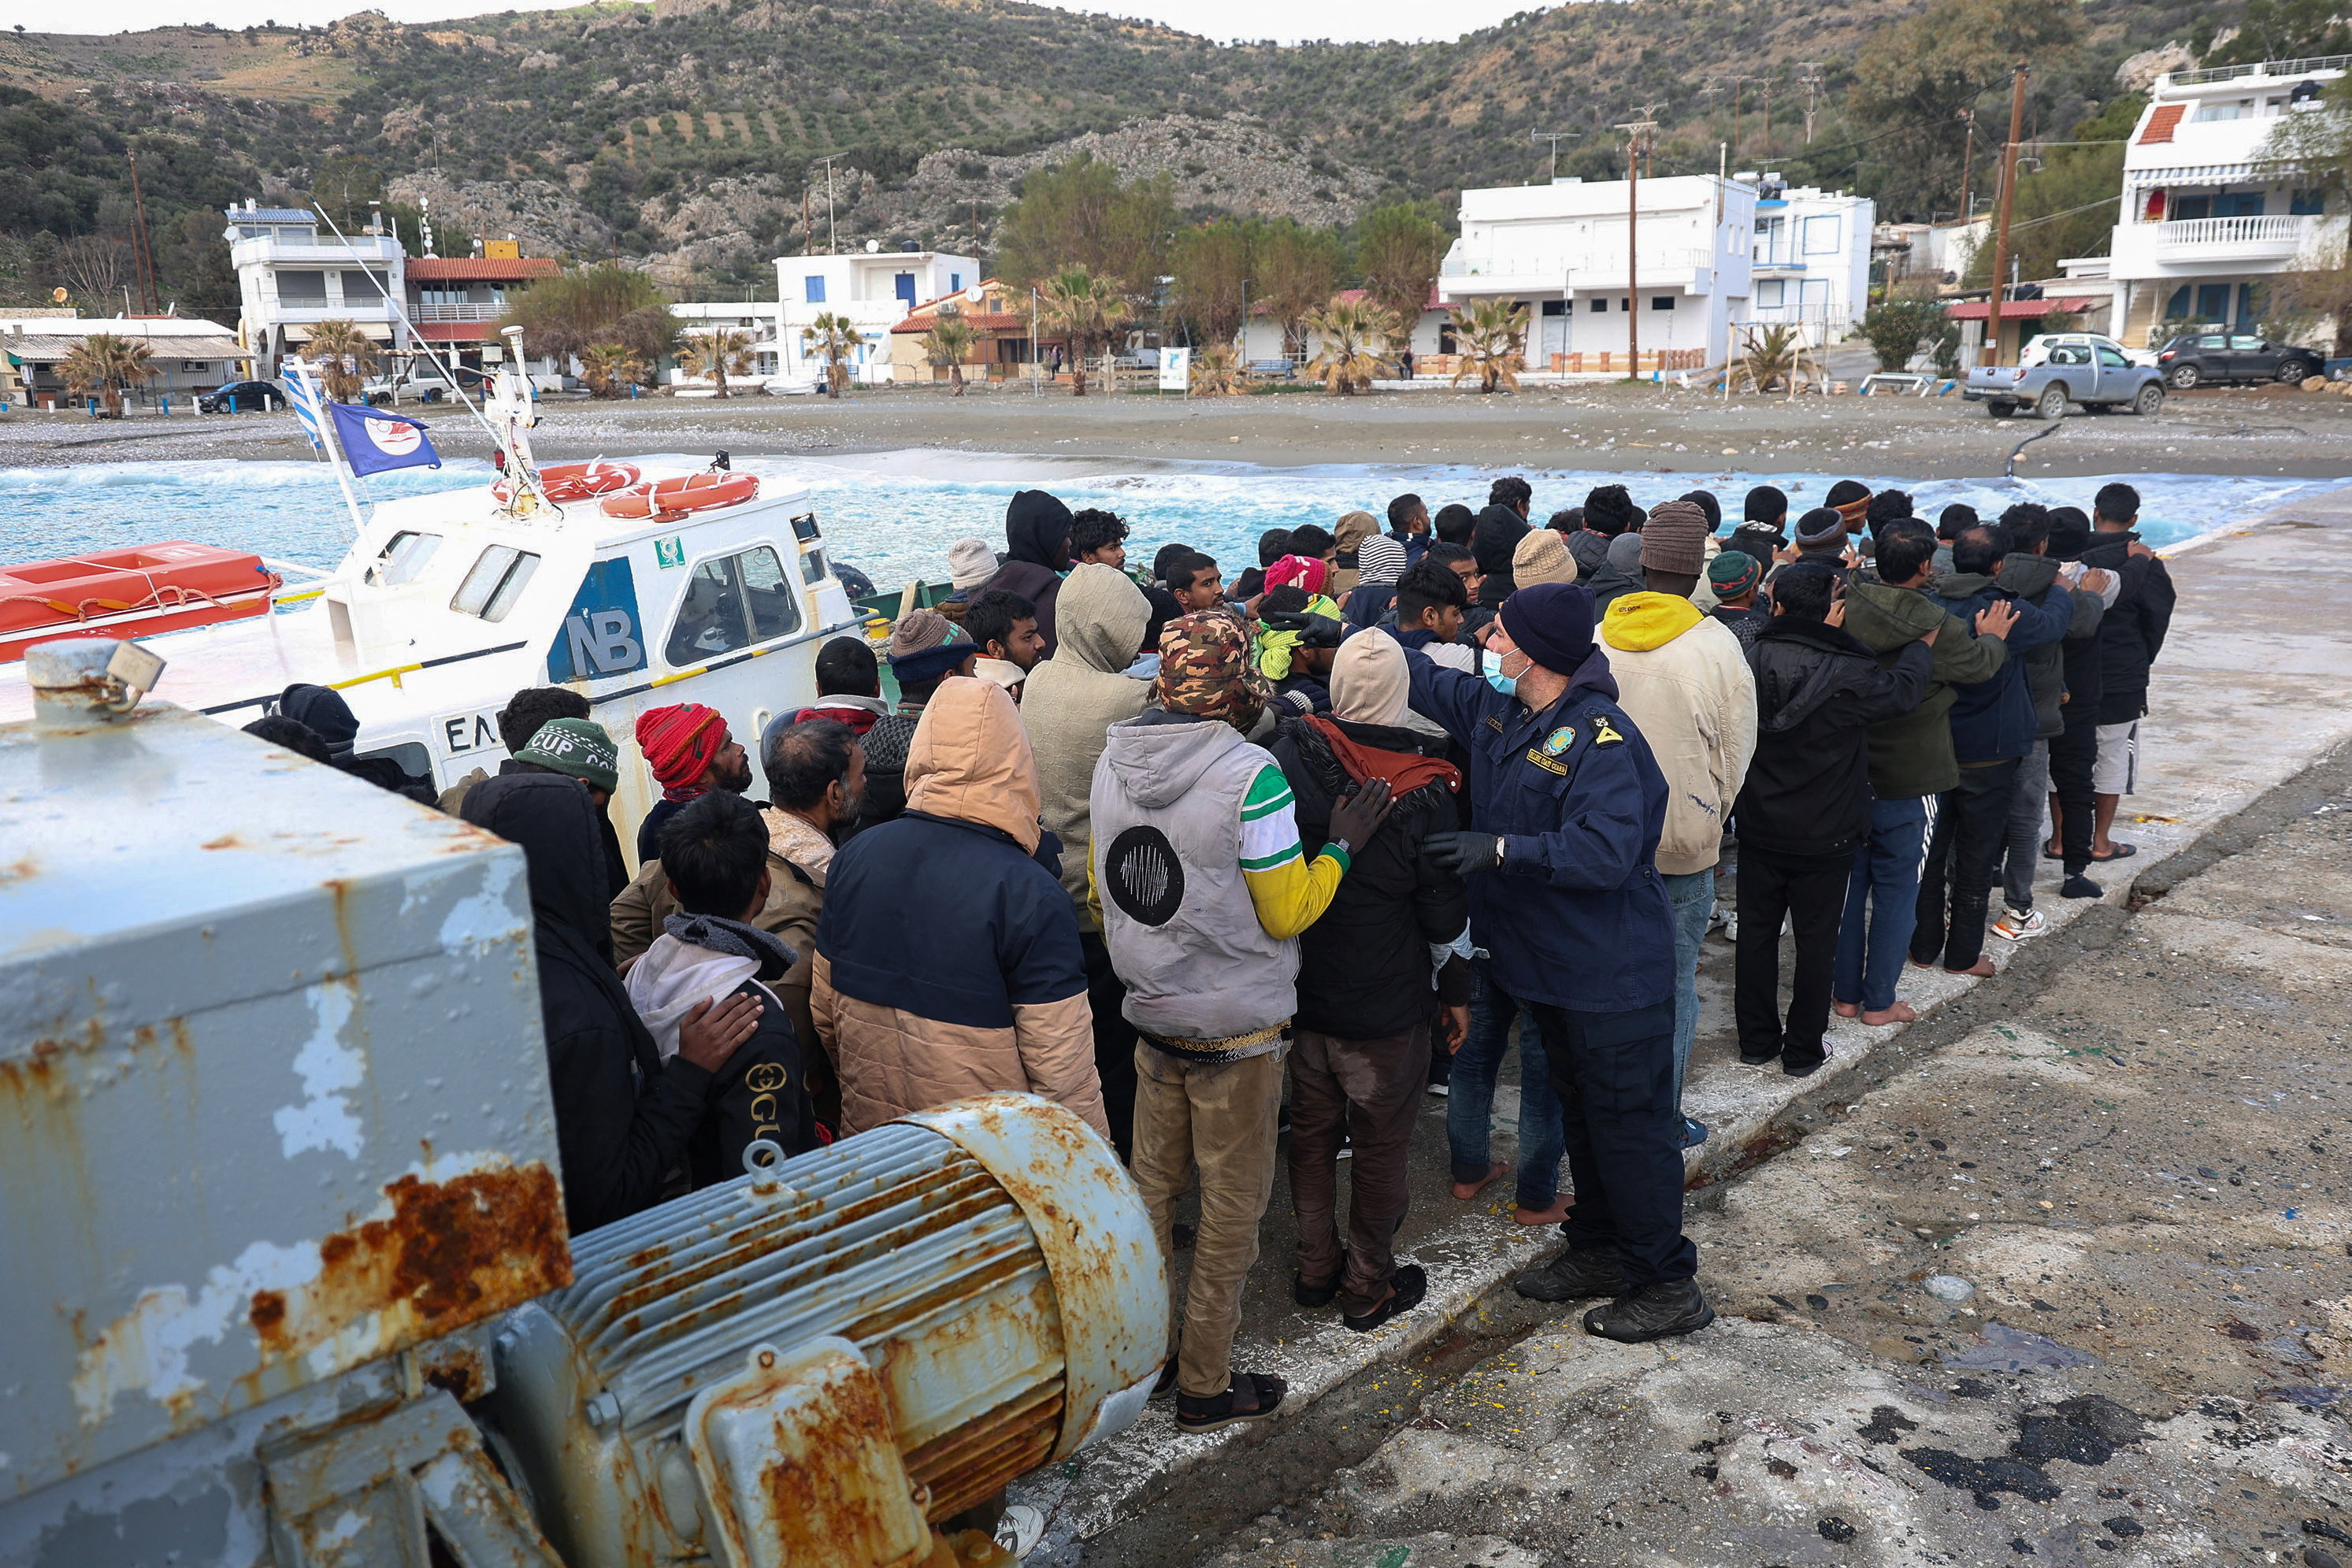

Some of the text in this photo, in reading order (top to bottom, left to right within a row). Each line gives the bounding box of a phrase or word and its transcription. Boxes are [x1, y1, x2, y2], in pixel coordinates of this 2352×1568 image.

[566, 610, 641, 677] NB
[445, 714, 496, 753] ΕΛ
[531, 732, 573, 757] CUP
